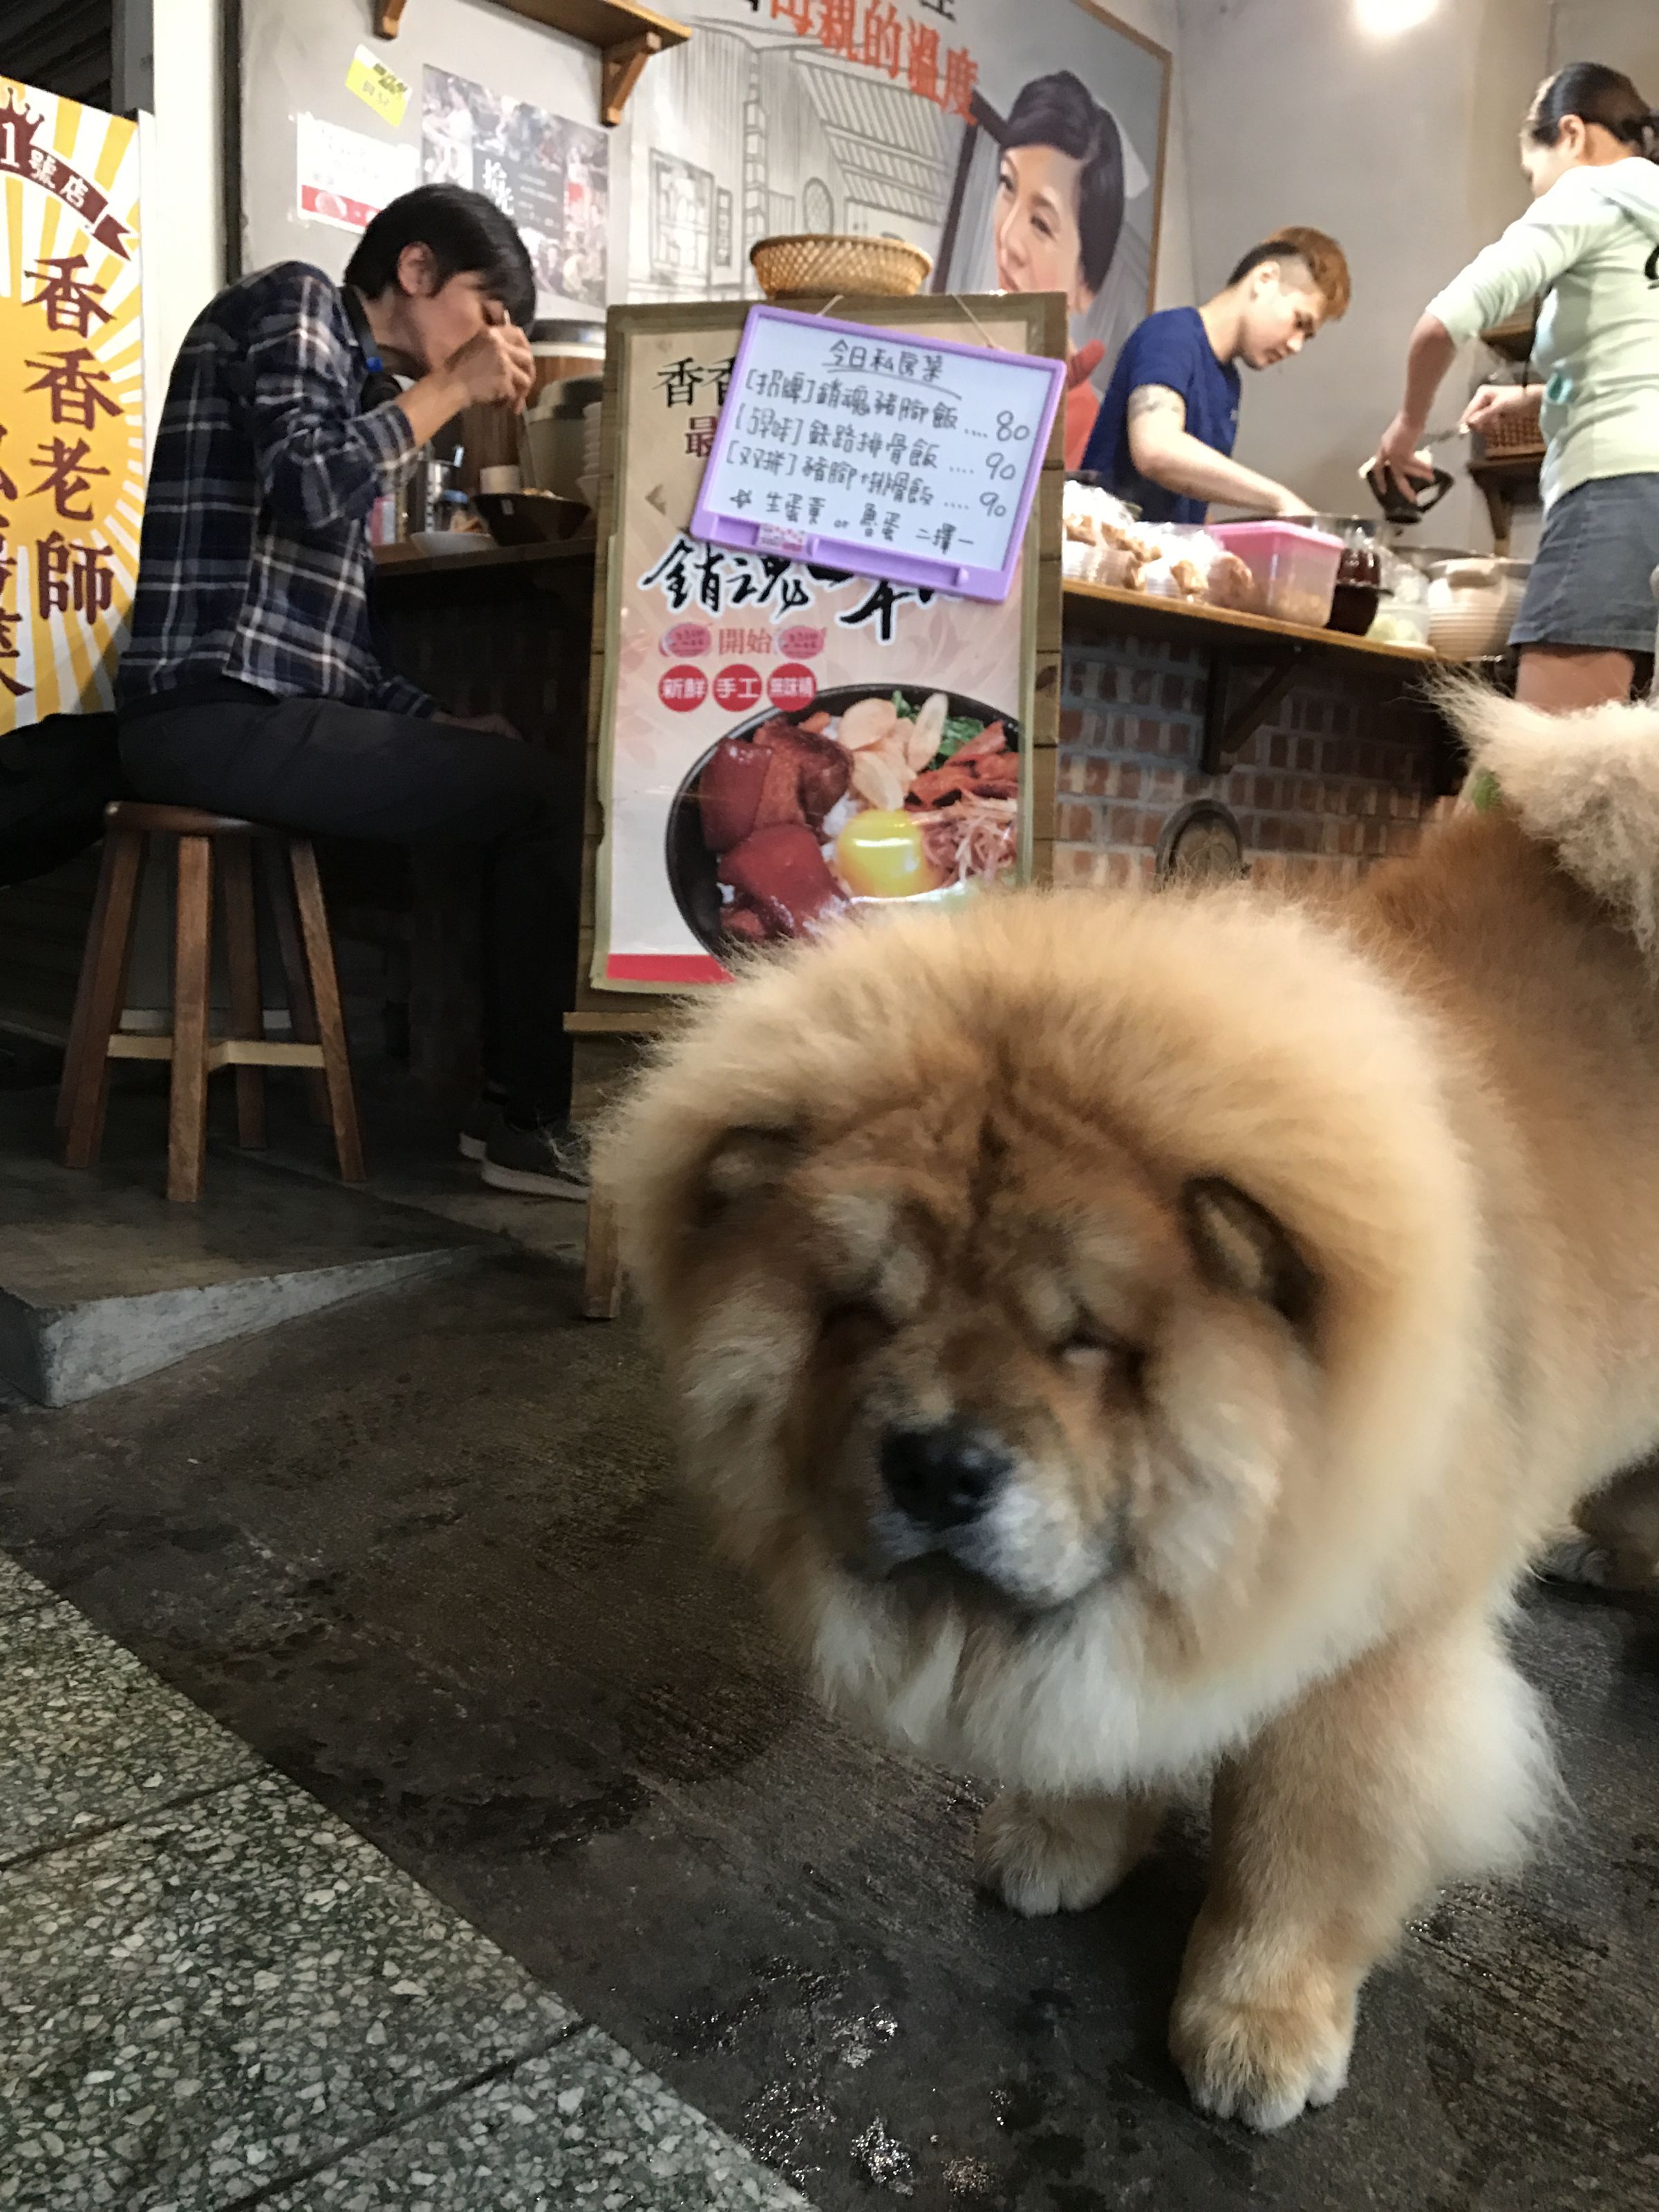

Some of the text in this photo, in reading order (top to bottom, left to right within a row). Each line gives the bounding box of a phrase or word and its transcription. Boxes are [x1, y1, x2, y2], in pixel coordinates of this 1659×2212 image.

[1, 122, 88, 208] 1號店
[828, 339, 944, 382] 今日私房菜
[21, 254, 124, 625] 香香老師
[684, 415, 719, 458] 最
[995, 410, 1030, 442] 80
[985, 451, 1017, 480] 90
[979, 491, 1007, 518] 90
[834, 518, 850, 529] or
[718, 628, 772, 655] 開始
[662, 677, 706, 699] 新鮮
[715, 677, 759, 698] 手工
